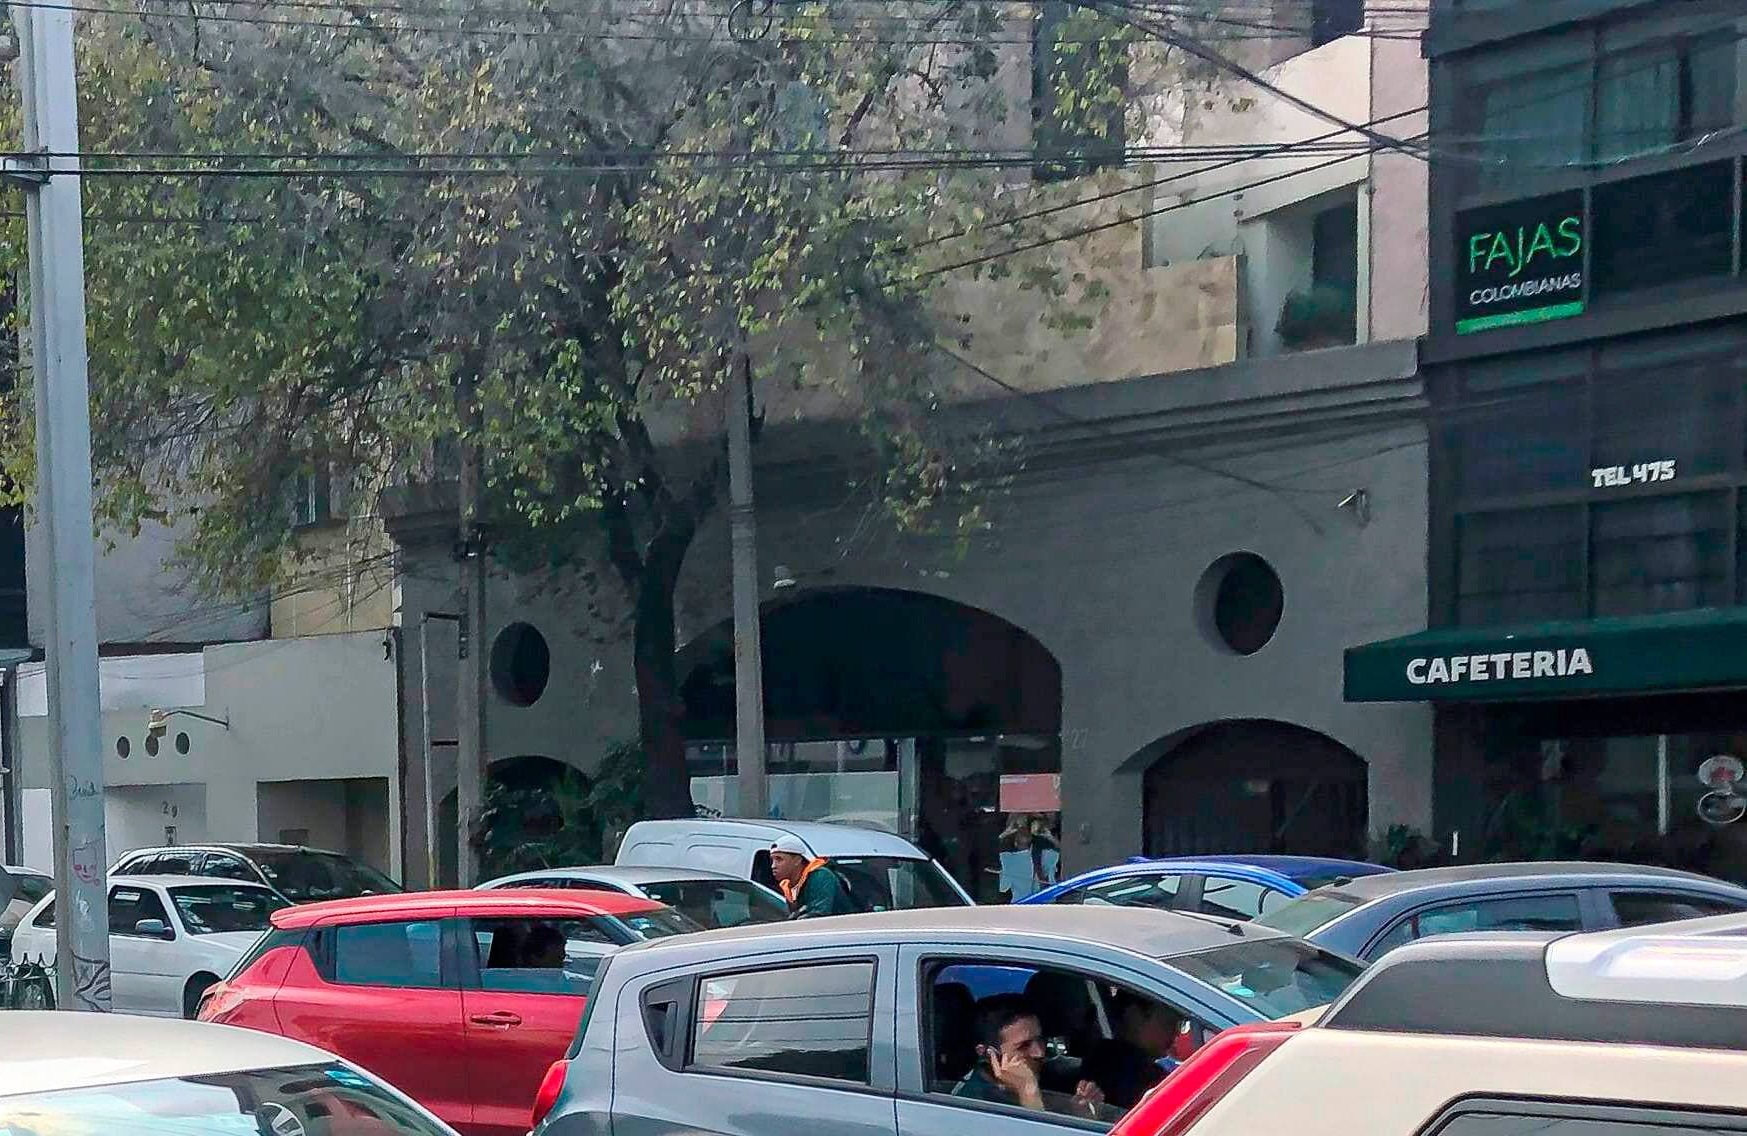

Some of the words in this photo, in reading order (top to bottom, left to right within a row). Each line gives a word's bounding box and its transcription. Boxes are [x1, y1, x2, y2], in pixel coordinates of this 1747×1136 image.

[1469, 216, 1581, 278] FAJAS
[1469, 272, 1583, 305] COLOMBIANAS
[1591, 465, 1632, 488] TEL
[1632, 459, 1676, 483] 475
[1406, 648, 1593, 685] CAFETERIA
